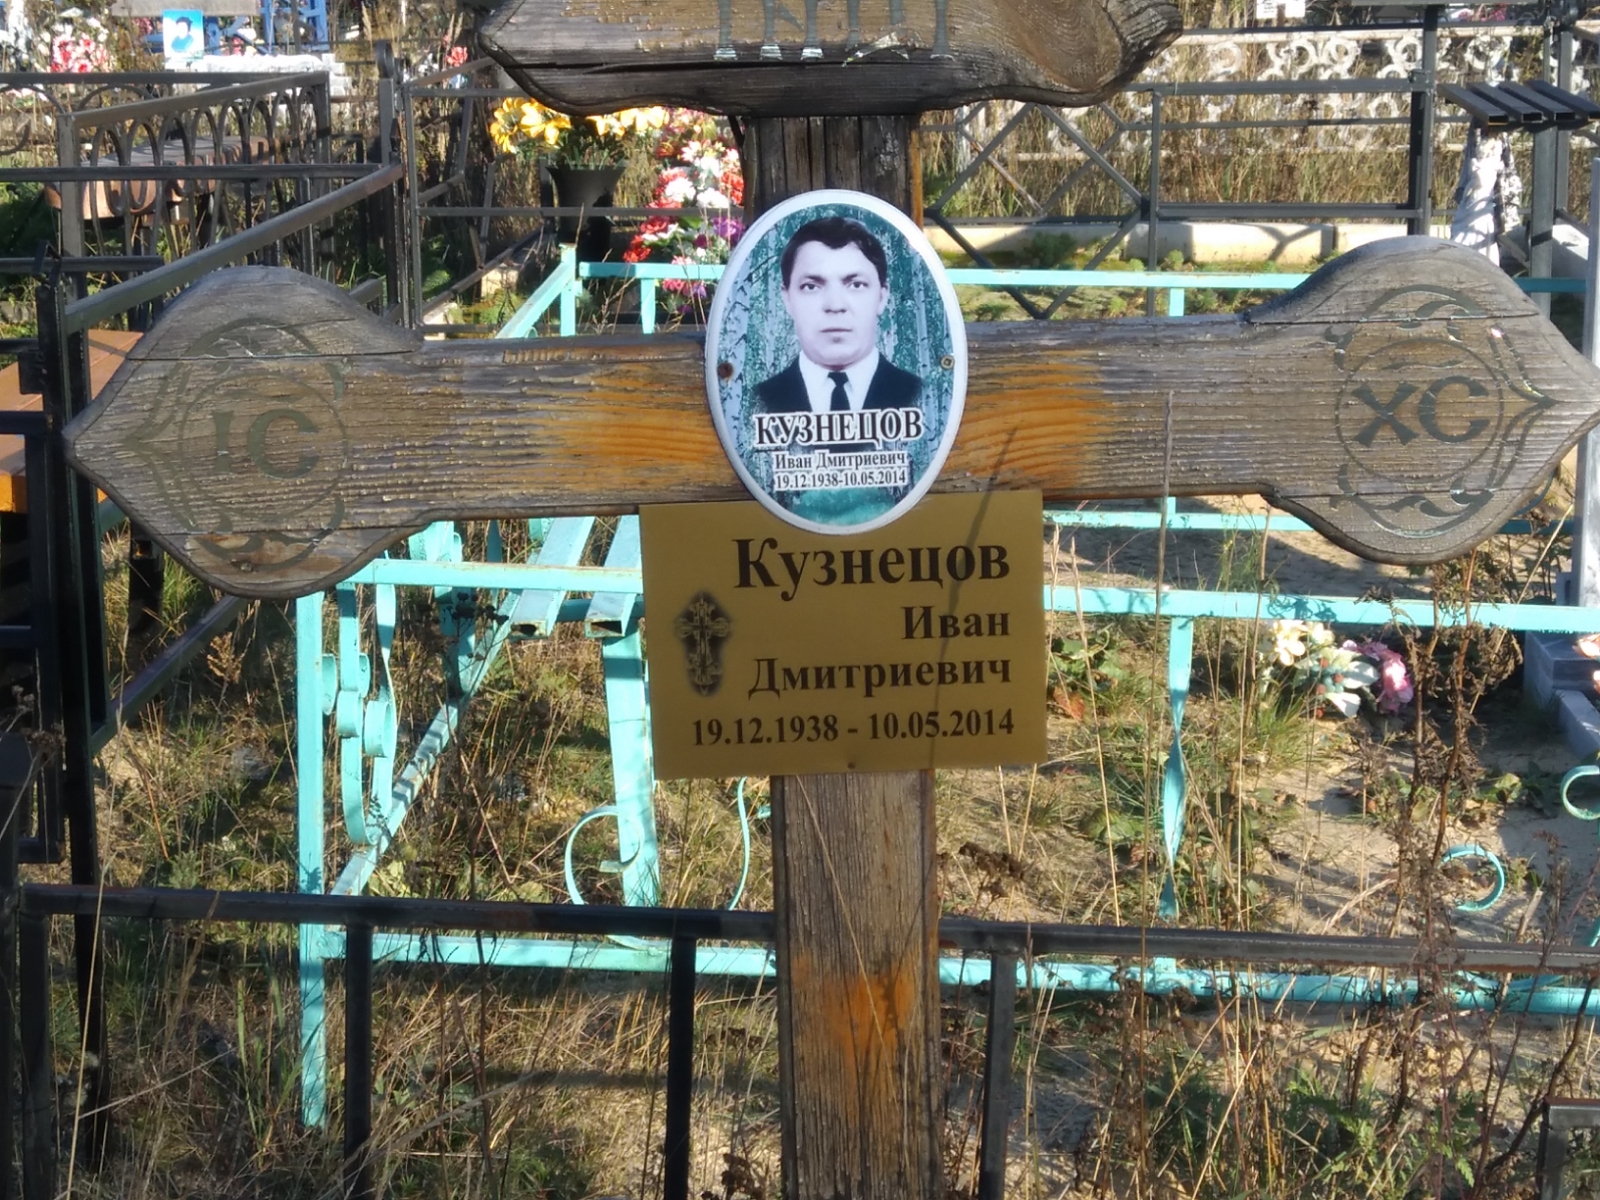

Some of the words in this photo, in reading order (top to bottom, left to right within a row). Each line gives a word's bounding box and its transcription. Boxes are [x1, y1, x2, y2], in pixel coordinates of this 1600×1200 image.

[755, 409, 923, 447] КУЗНЕЦОВ
[775, 453, 812, 470] Иван
[816, 451, 906, 470] Дмитриевич
[733, 536, 1011, 601] Кузнецов
[901, 605, 1011, 640] Иван
[748, 657, 1012, 700] Дмитриевич
[693, 713, 839, 746] 19.12.1938
[868, 707, 1014, 741] 10.05.2014
